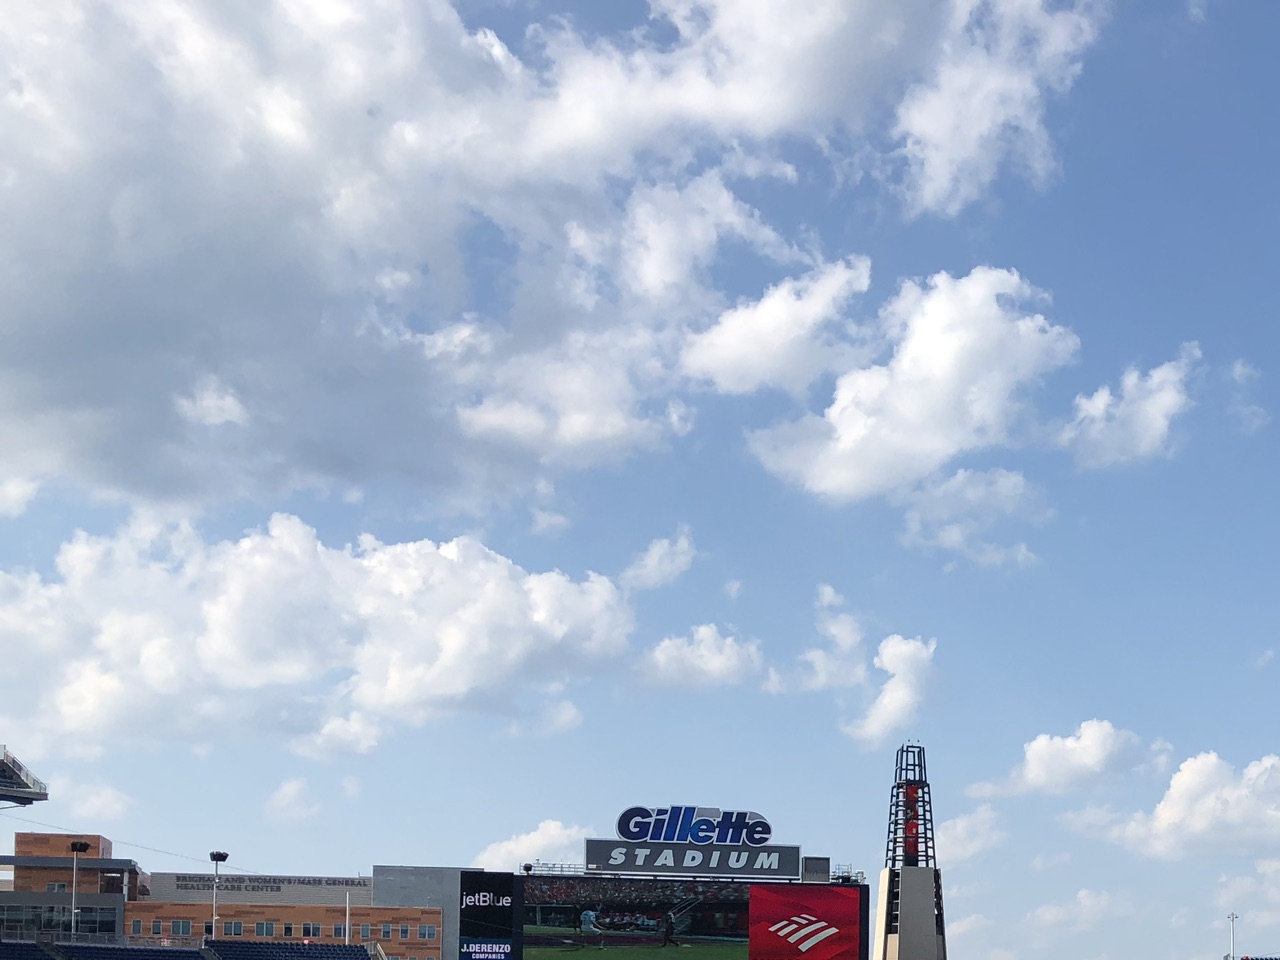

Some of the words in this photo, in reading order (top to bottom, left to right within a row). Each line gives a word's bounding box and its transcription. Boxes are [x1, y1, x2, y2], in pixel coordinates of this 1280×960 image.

[616, 806, 772, 847] Gillette
[608, 848, 779, 870] STADIUM
[224, 876, 245, 884] AND
[325, 878, 368, 887] GENERAL
[244, 884, 282, 892] CENTER
[461, 892, 511, 908] jetBlue
[461, 944, 511, 953] J.DERENZO
